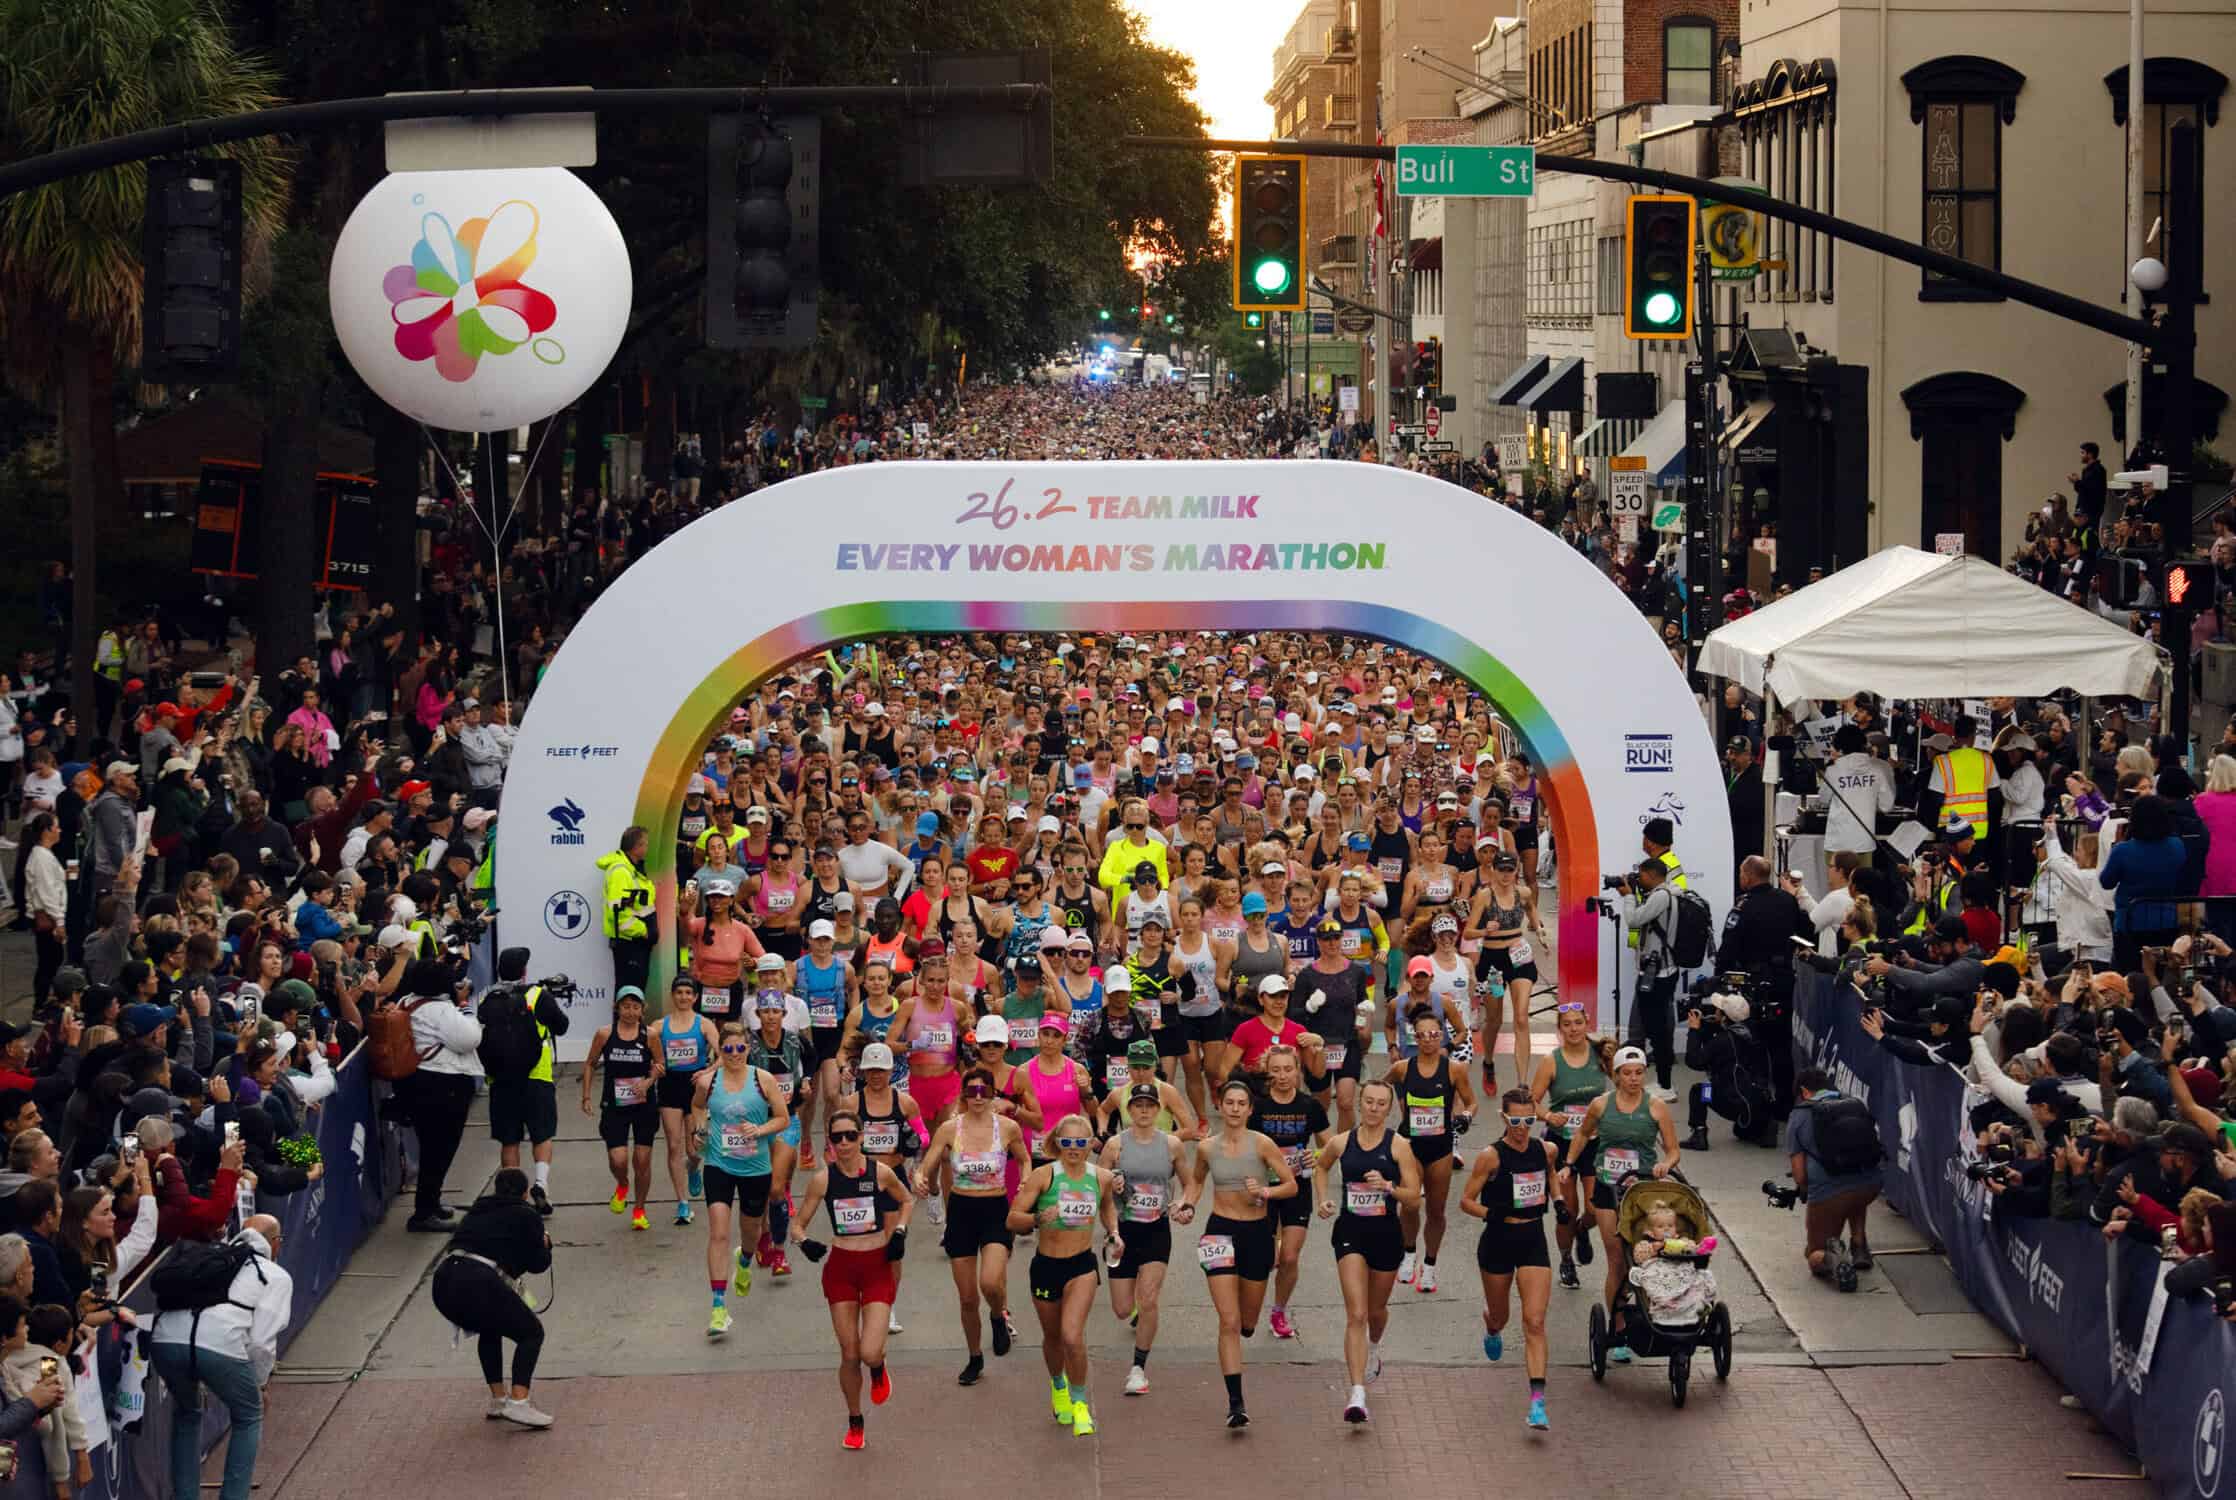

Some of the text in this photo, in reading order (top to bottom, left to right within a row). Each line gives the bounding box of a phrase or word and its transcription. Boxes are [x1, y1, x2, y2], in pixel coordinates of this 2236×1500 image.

[1400, 158, 1530, 184] Bull St
[1930, 105, 1958, 279] TATTO
[1613, 475, 1643, 483] SPEED
[1616, 485, 1640, 493] LIMIT
[955, 478, 1261, 531] 26.2 TEAM MILK
[1615, 494, 1642, 511] 30
[836, 542, 1387, 572] EVERY WOMAN'S MARATHON
[328, 561, 370, 574] 3715
[546, 747, 620, 757] FLEET FEET
[1627, 749, 1673, 765] RUN!
[1838, 774, 1877, 789] STAFF
[551, 832, 585, 845] rabbit
[1011, 1028, 1036, 1039] 7920
[671, 1048, 695, 1057] 7202
[1263, 1120, 1307, 1134] RISE
[1415, 1116, 1439, 1127] 8147
[868, 1135, 896, 1146] 5893
[964, 1163, 992, 1174] 3386
[1609, 1158, 1633, 1170] 5715
[1520, 1183, 1542, 1197] 5393
[1131, 1195, 1158, 1207] 5428
[1351, 1193, 1381, 1206] 7077
[841, 1209, 867, 1222] 1567
[1063, 1204, 1093, 1216] 4422
[1202, 1245, 1226, 1258] 1547
[2038, 1262, 2065, 1313] FEET
